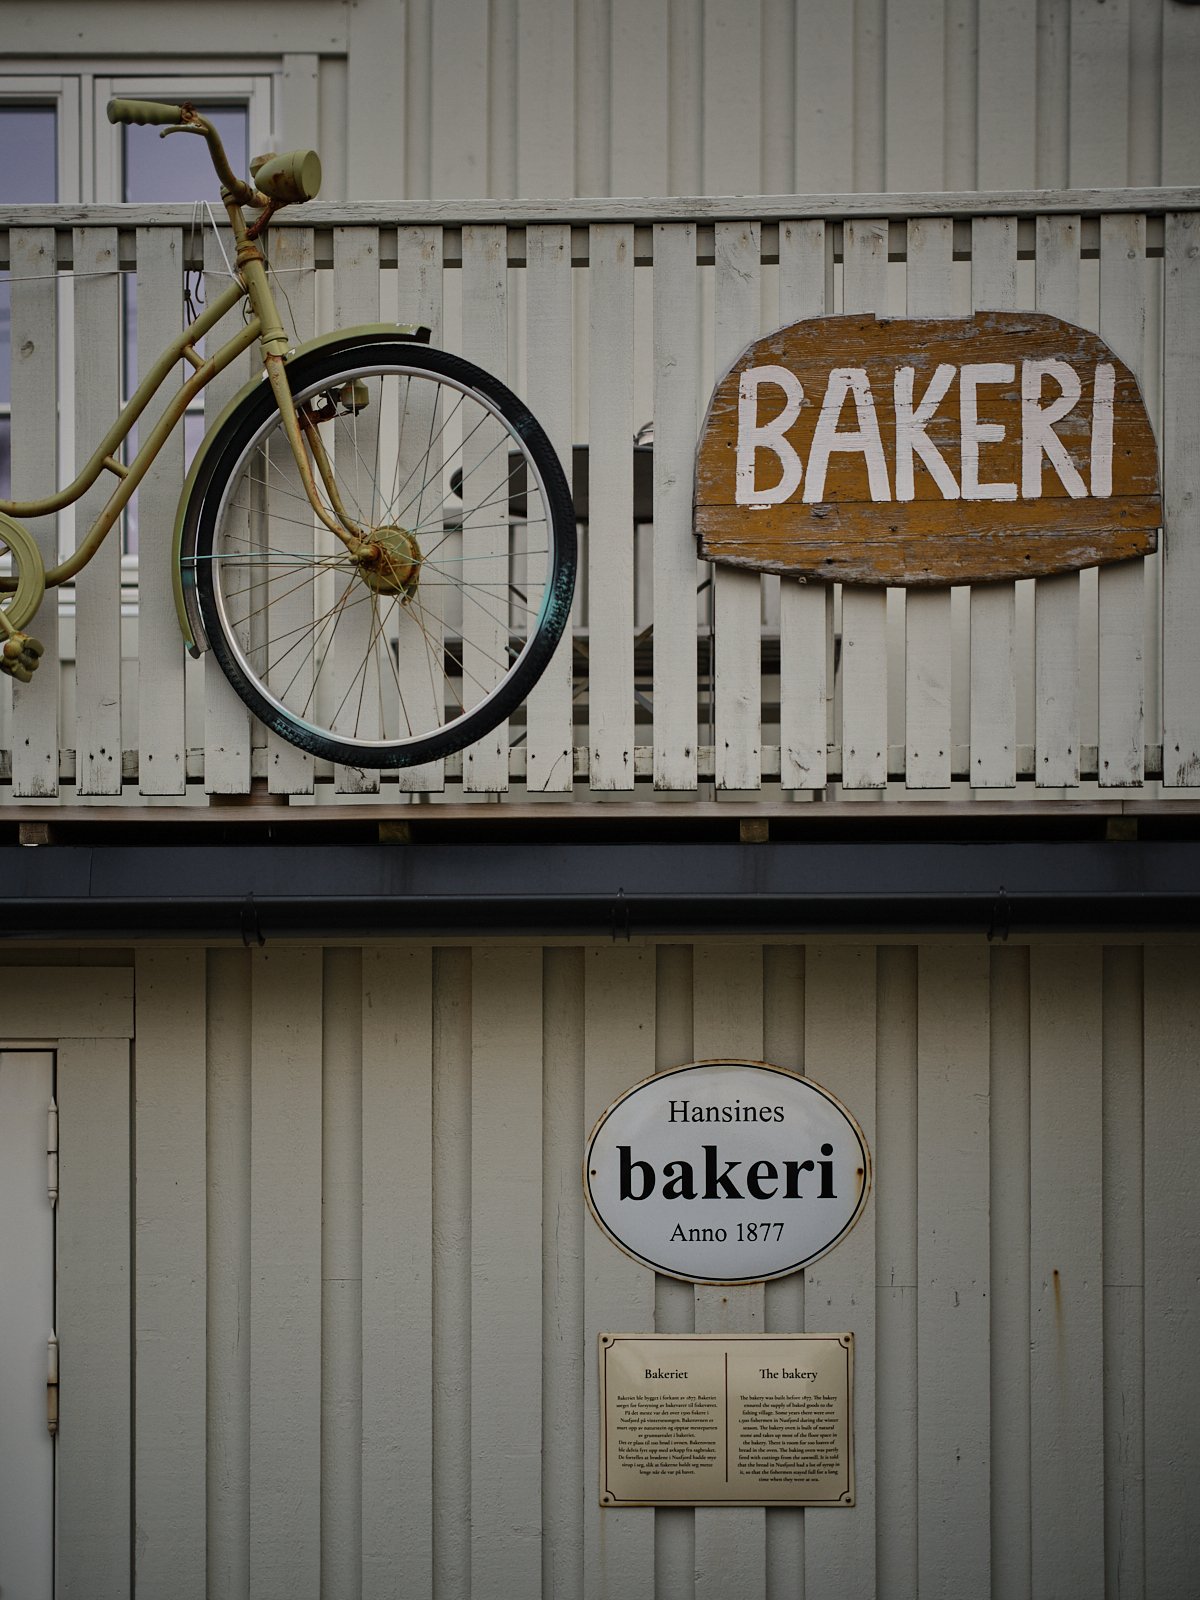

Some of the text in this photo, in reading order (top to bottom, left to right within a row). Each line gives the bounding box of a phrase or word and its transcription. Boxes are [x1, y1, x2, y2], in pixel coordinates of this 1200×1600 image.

[735, 359, 1115, 507] BAKERI
[668, 1099, 785, 1123] Hansines
[616, 1143, 838, 1201] bakeri
[670, 1223, 784, 1242] Anno 1877
[645, 1368, 688, 1379] Bakeriet
[759, 1368, 818, 1382] The bakery
